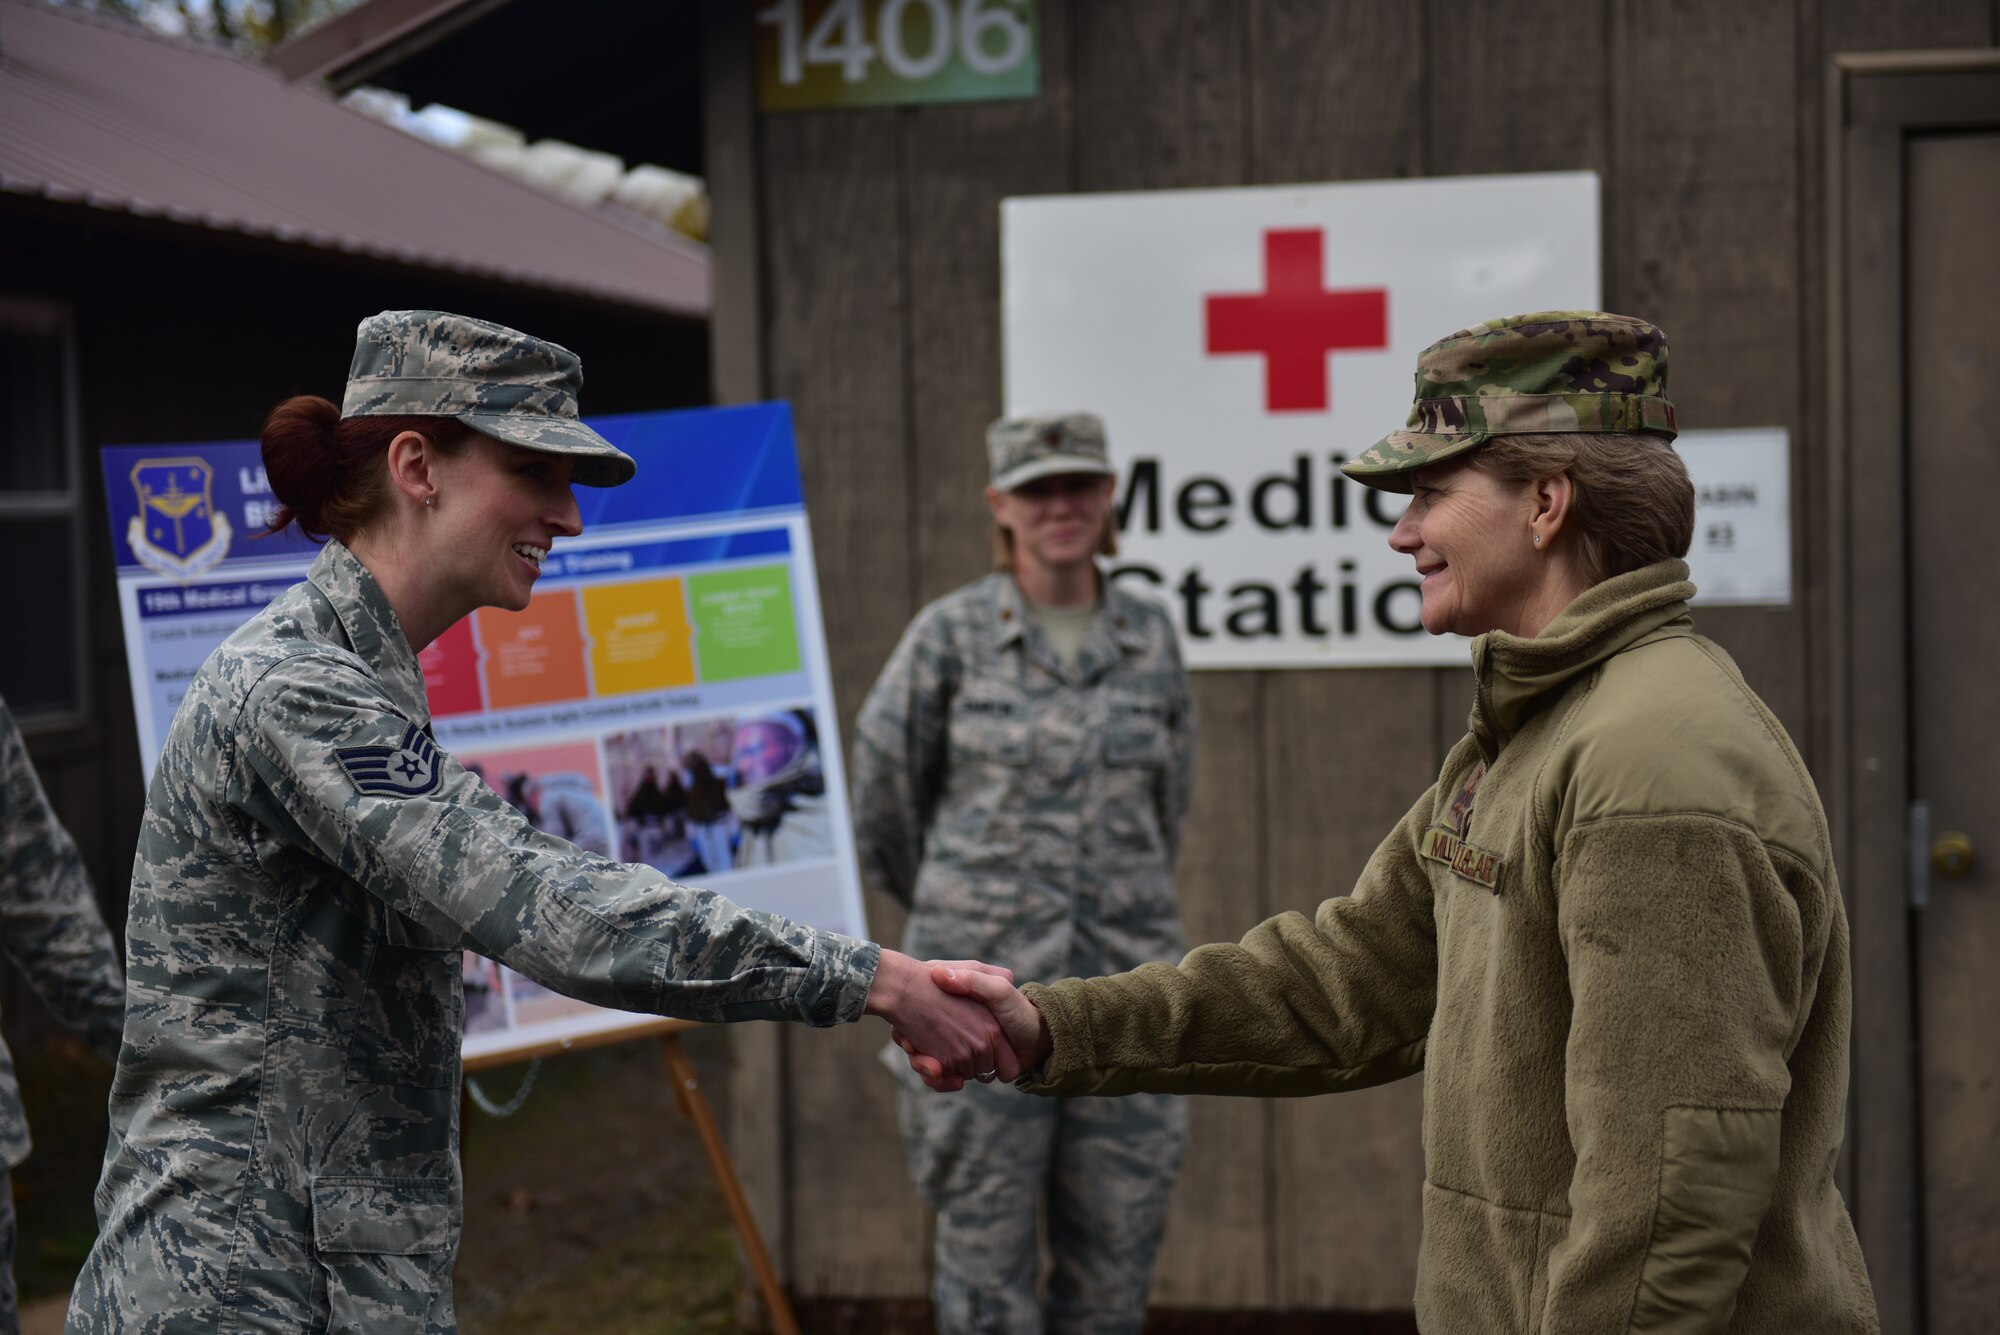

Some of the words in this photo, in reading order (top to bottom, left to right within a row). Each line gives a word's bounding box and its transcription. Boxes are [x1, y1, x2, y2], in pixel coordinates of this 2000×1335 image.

[757, 0, 1033, 84] 1406
[1114, 452, 1404, 534] Medic
[1697, 485, 1757, 509] ABIN
[144, 592, 182, 612] 19th
[184, 585, 247, 608] Medical
[1109, 558, 1424, 639] tatio
